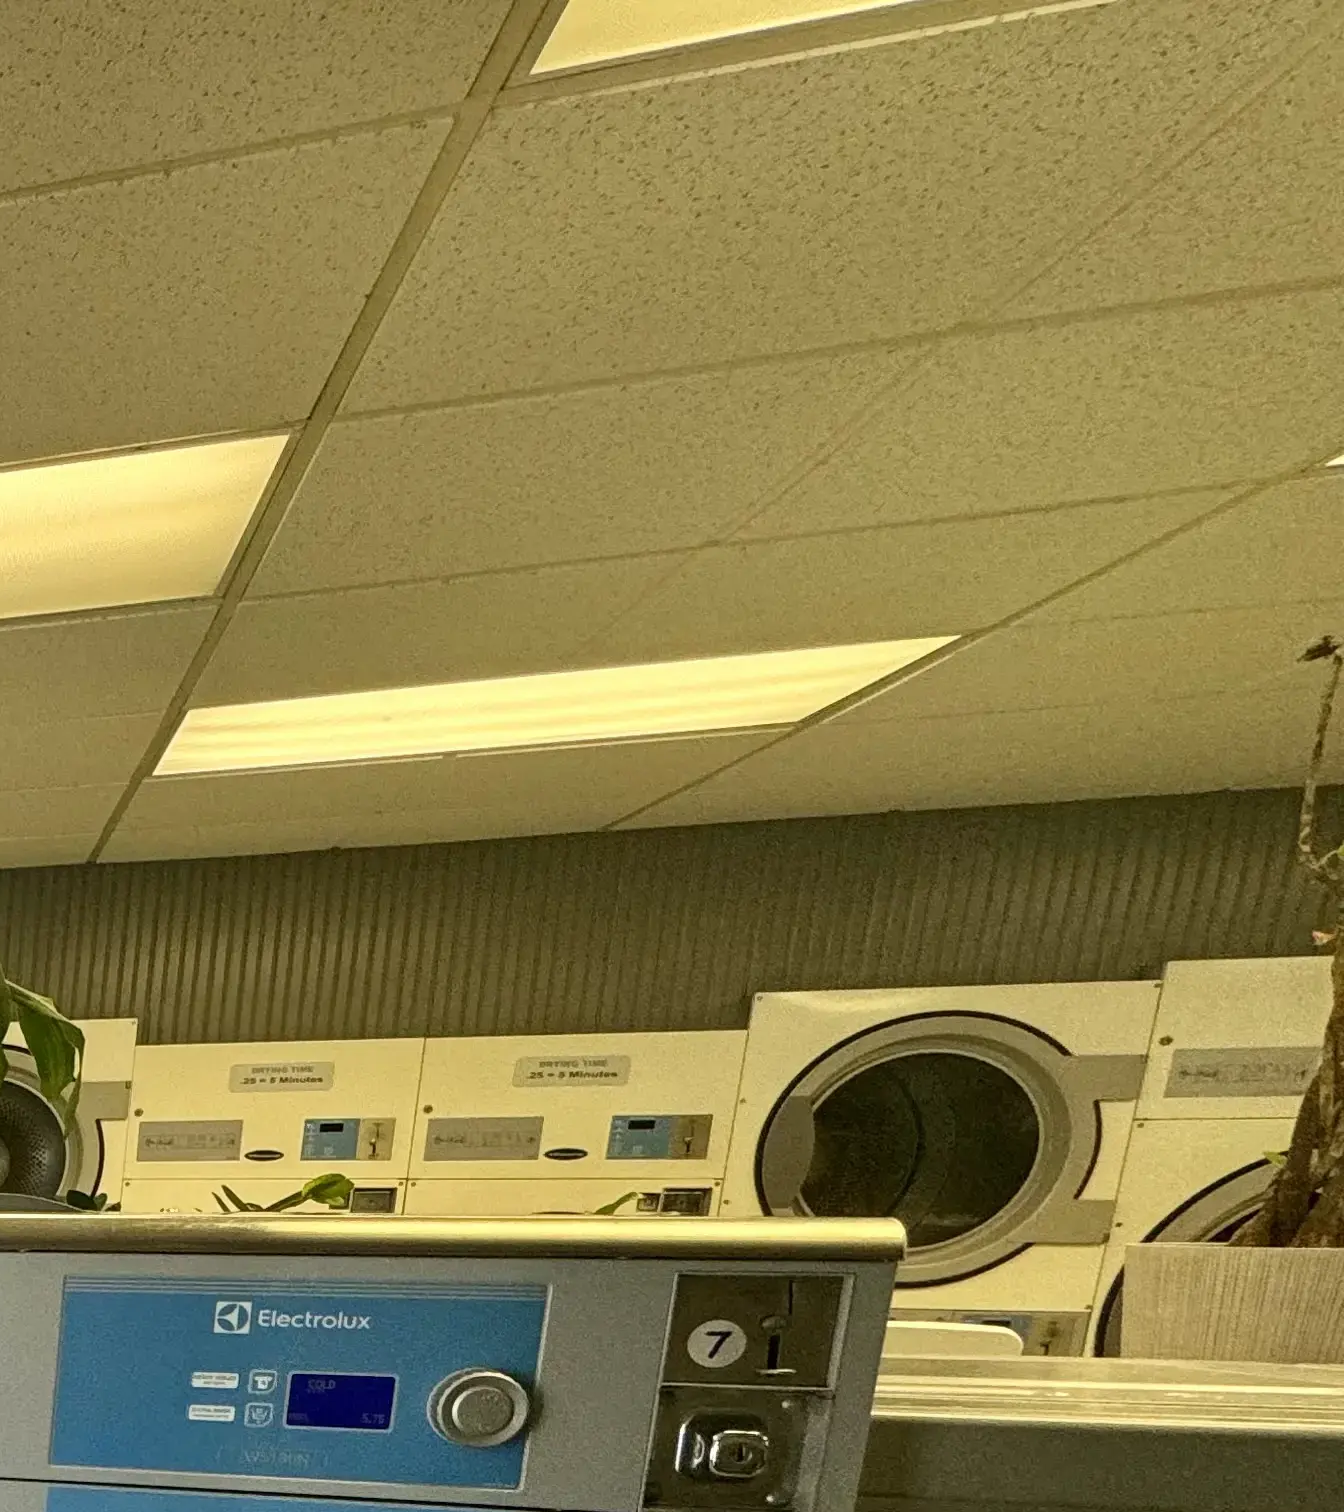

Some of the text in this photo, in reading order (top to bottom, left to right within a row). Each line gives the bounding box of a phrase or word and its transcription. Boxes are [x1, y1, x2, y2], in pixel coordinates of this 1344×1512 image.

[279, 1076, 324, 1084] Minutes
[569, 1071, 618, 1079] Minutes
[257, 1308, 373, 1331] Electrolux
[704, 1330, 733, 1359] 7
